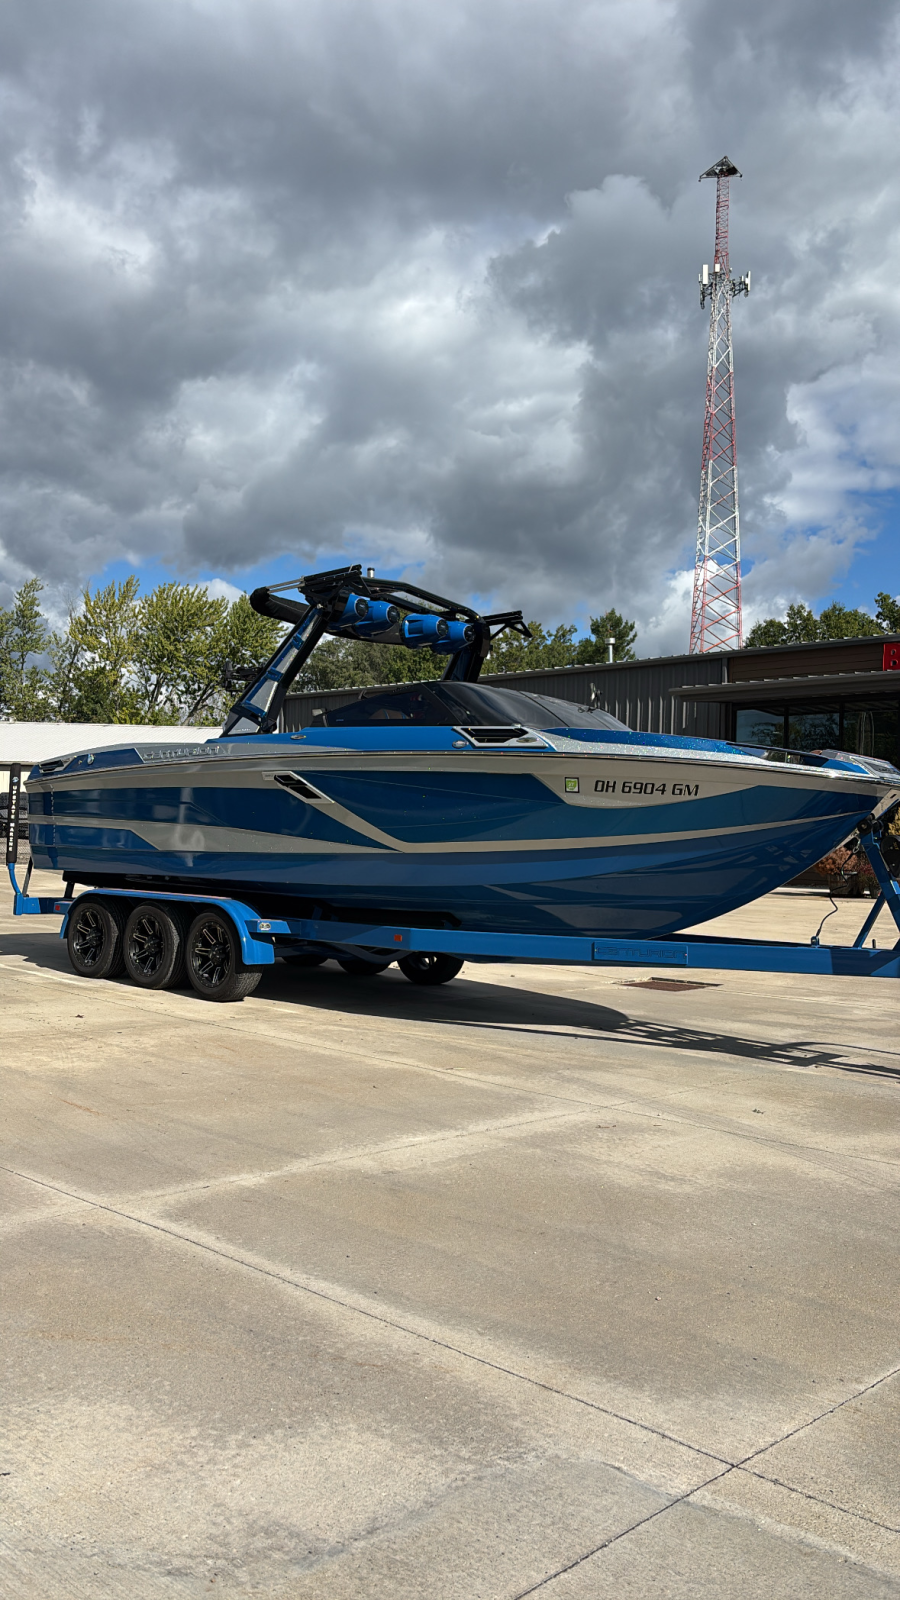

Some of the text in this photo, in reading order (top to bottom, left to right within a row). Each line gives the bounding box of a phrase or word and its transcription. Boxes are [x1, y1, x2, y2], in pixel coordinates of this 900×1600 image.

[594, 780, 699, 797] OH 6904 GM
